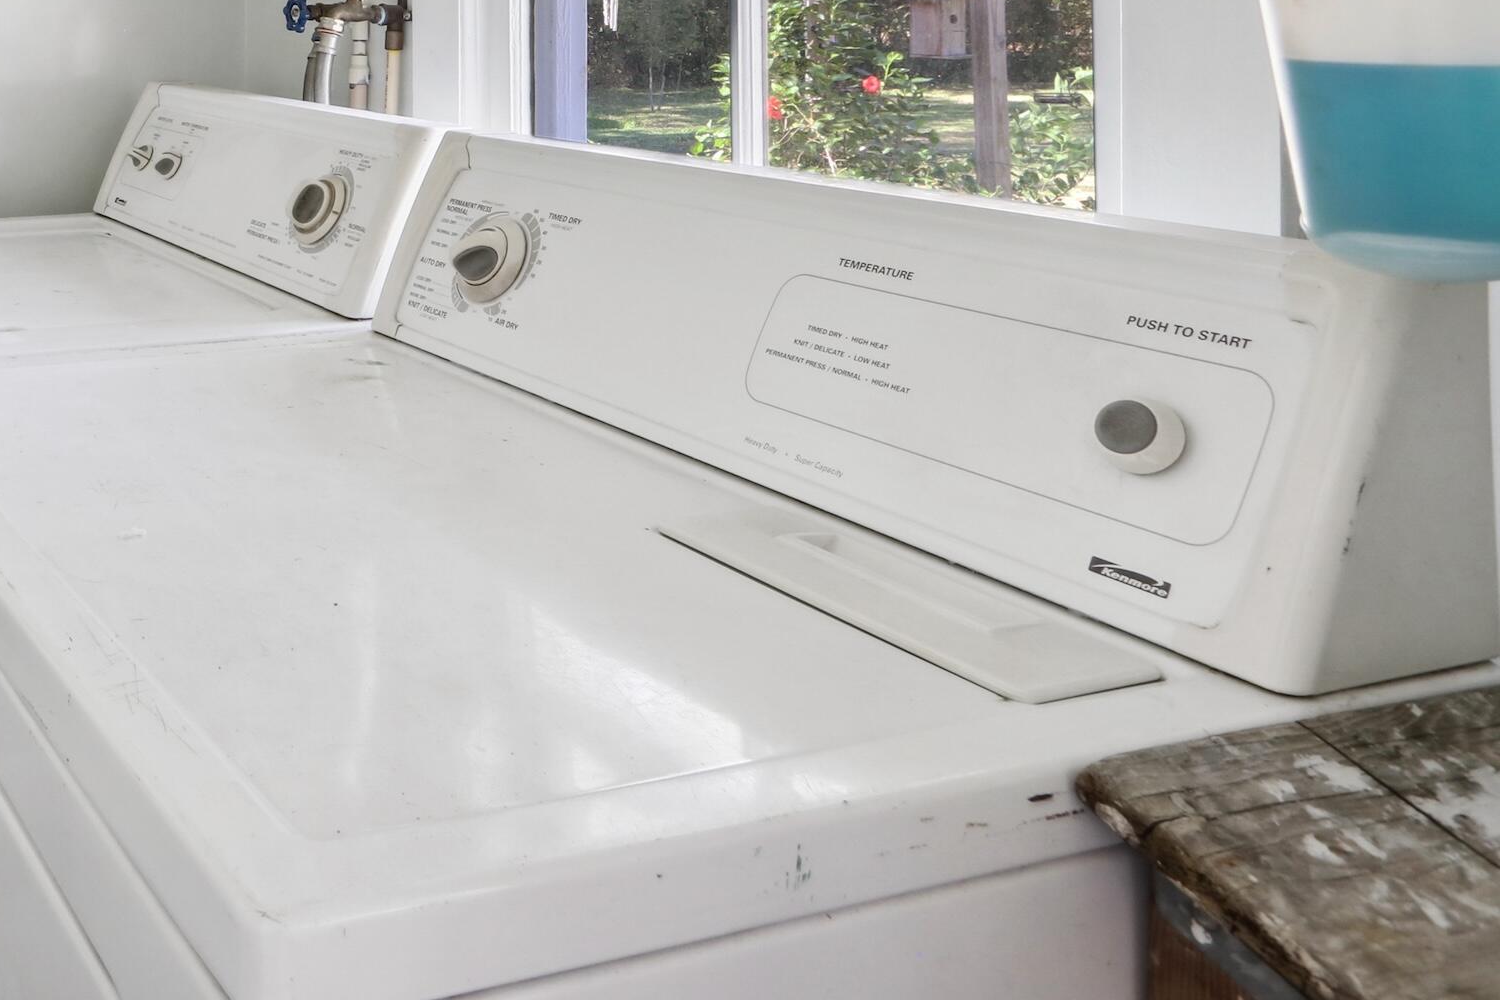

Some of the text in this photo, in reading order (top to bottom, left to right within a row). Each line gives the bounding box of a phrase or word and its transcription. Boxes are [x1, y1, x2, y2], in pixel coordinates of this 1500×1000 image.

[449, 198, 477, 209] PERMANENT
[477, 203, 493, 213] PRESS
[548, 212, 583, 225] TIMED DRY
[420, 256, 446, 269] AUTO DRY
[838, 257, 914, 281] TEMPERATURE
[407, 299, 421, 309] KNIT
[424, 305, 448, 319] DELICATE
[494, 317, 519, 331] AIR DRY
[1126, 314, 1252, 350] PUSH TO START
[807, 324, 889, 351] TIMED DRY HIGH HEAT
[794, 338, 809, 348] KNIT
[814, 343, 845, 358] DELICATE
[853, 354, 870, 364] LOW
[871, 359, 891, 370] HEAT
[765, 348, 805, 363] PERMANENT
[805, 359, 826, 371] PRESS
[832, 367, 861, 381] NORMAL
[871, 378, 889, 388] HIGH
[890, 383, 911, 394] HEAT
[763, 442, 778, 454] Duty
[794, 454, 814, 465] Super
[814, 461, 844, 478] Capacity
[1100, 565, 1168, 598] Kenmore
